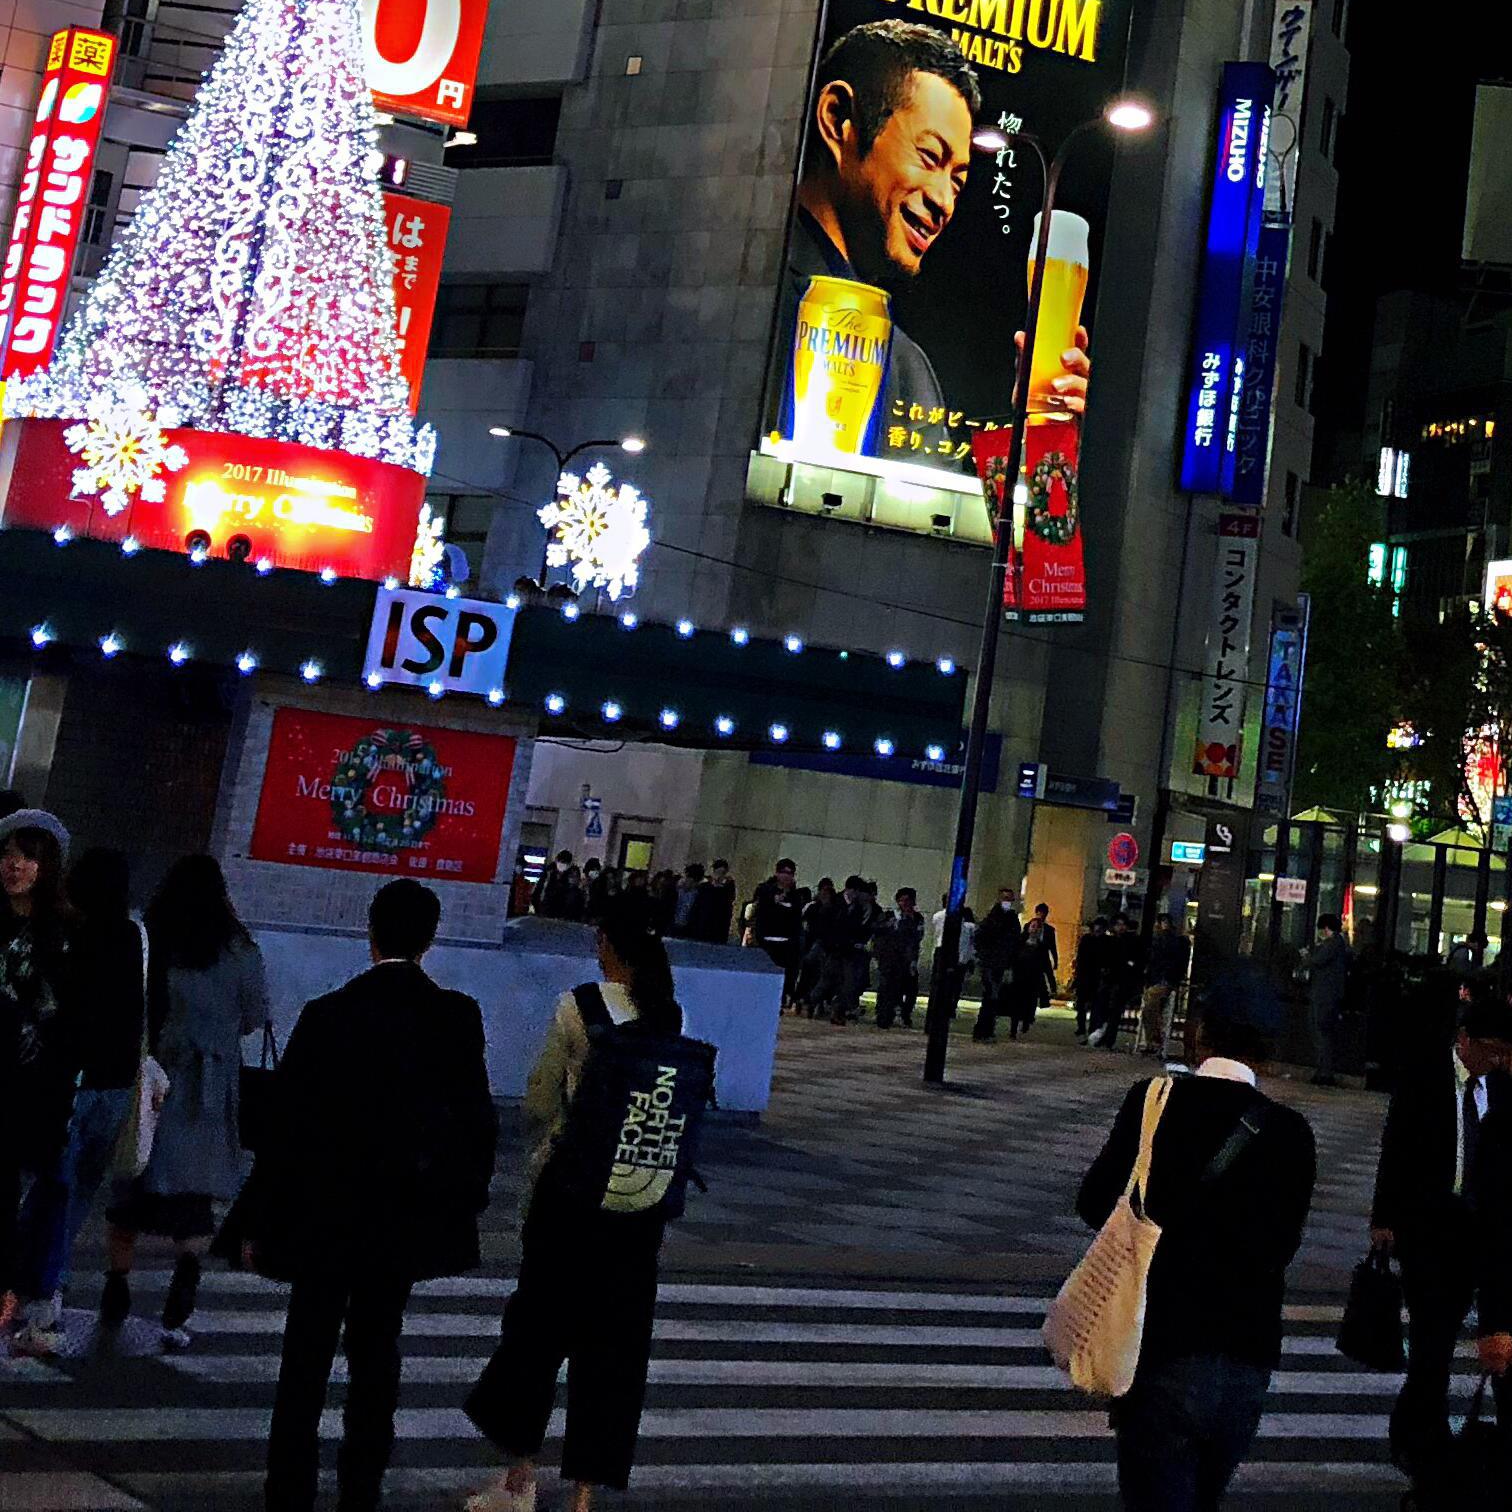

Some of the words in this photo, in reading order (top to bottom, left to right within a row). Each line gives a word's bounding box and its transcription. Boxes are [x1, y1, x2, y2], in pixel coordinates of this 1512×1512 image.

[74, 36, 109, 70] 薬
[1227, 98, 1252, 183] MIZUHO
[797, 320, 888, 366] PREMIUM
[1194, 352, 1221, 447] みずほ銀行
[222, 463, 262, 482] 2017
[1226, 520, 1254, 535] 4F
[382, 601, 498, 678] ISP
[1209, 549, 1246, 726] コンタクトレンズ
[295, 774, 362, 809] Merry
[371, 785, 476, 817] Christmas
[614, 1089, 651, 1163] FACE
[637, 1065, 678, 1166] NORTH
[656, 1113, 687, 1168] THE
